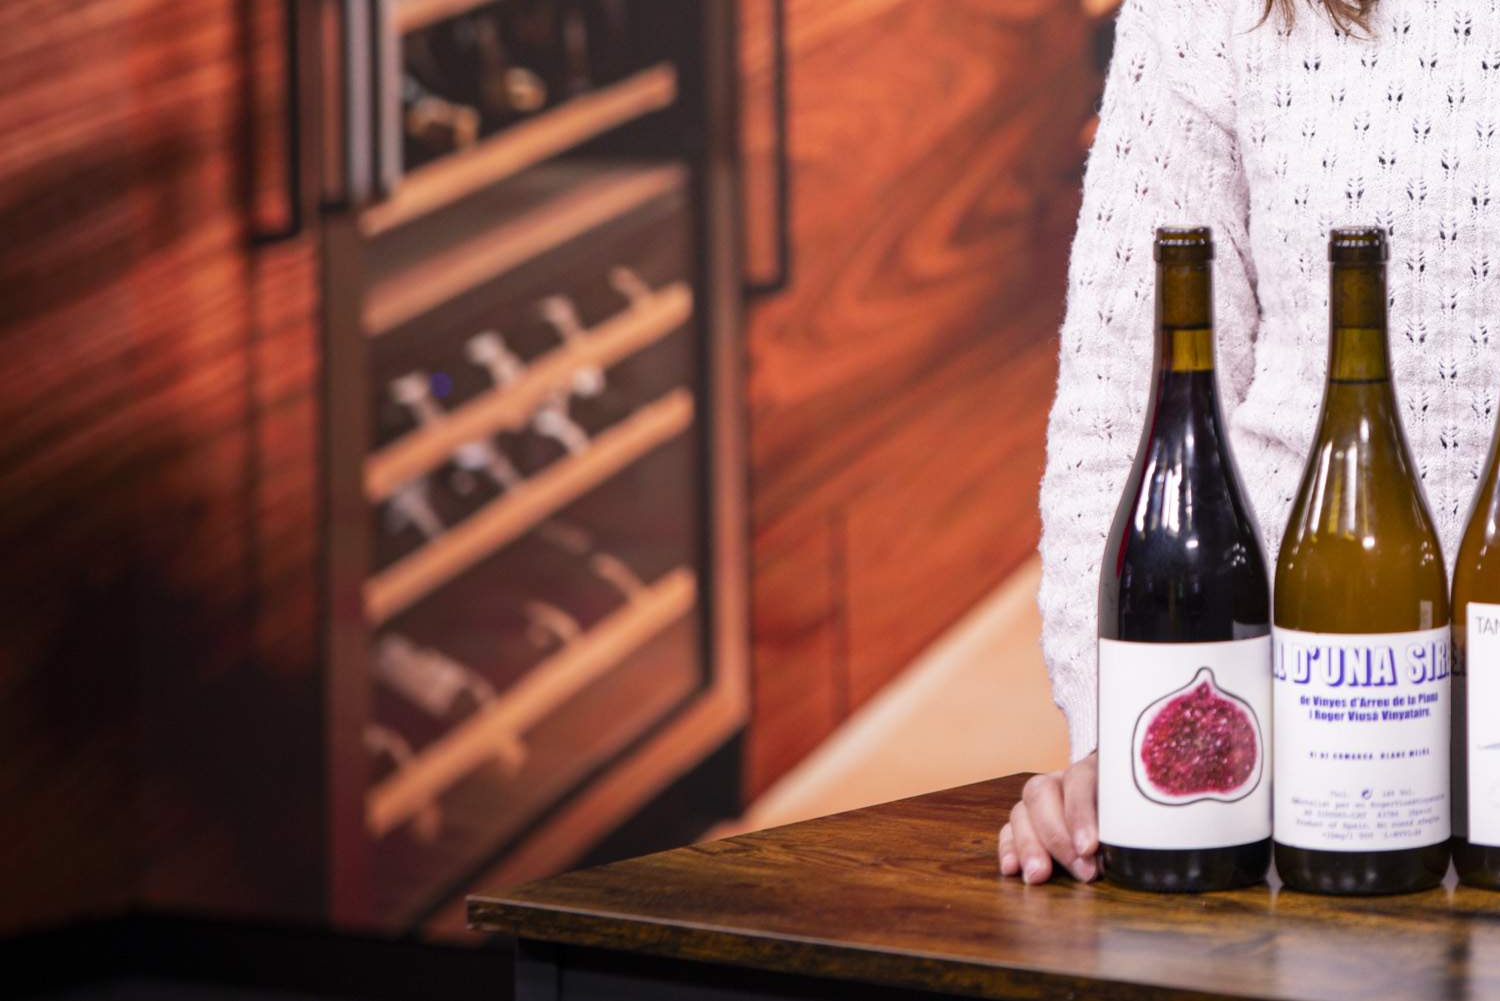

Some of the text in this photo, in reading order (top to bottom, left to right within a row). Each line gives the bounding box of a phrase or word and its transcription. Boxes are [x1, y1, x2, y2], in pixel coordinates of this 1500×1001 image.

[1290, 643, 1399, 688] D'UNA
[1313, 695, 1346, 708] Vinyes
[1392, 695, 1405, 707] de
[1314, 709, 1345, 722] Roger
